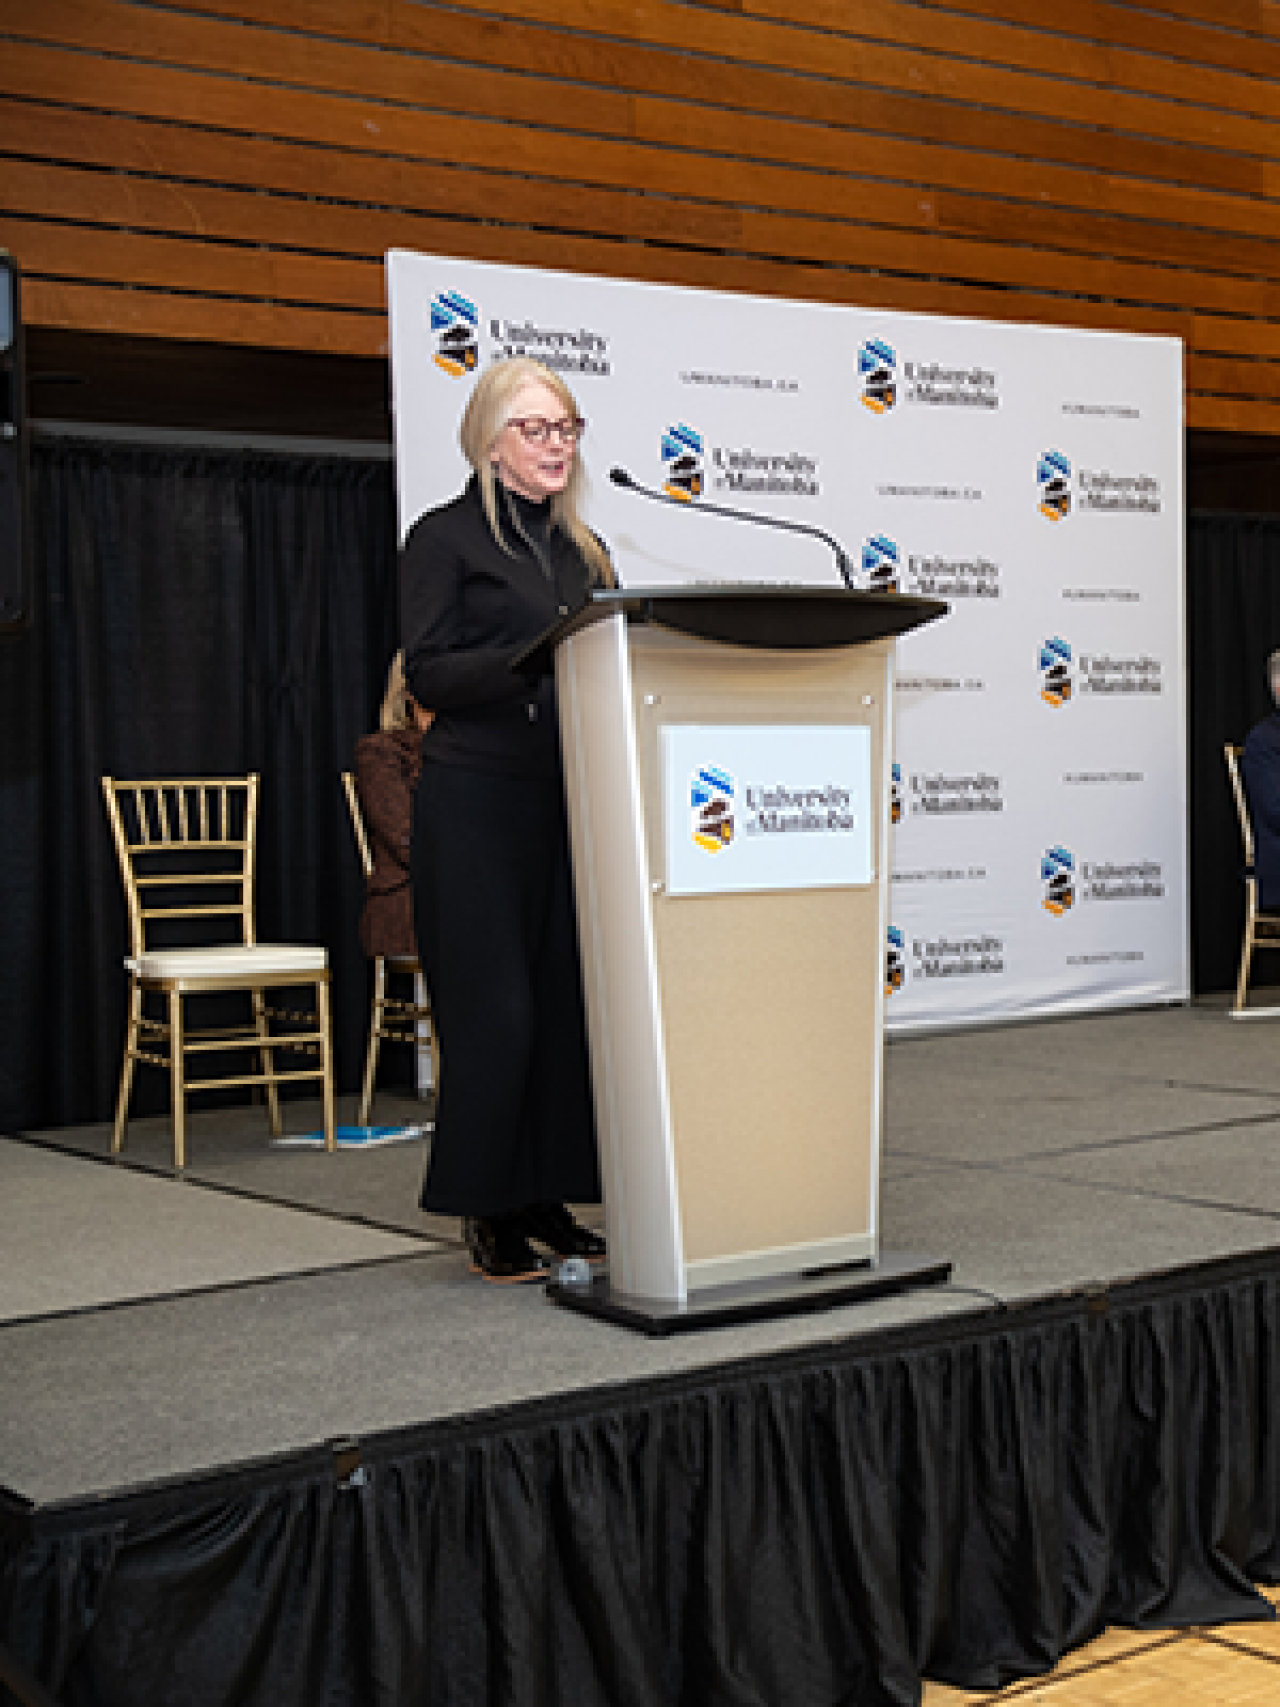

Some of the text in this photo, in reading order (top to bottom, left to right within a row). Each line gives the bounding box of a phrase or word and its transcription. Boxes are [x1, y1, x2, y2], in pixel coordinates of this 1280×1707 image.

[490, 319, 610, 351] University
[904, 361, 997, 389] University
[915, 383, 999, 411] Manitoba
[712, 446, 817, 474] University
[726, 472, 820, 496] Manitoba
[1079, 469, 1161, 496] University
[1087, 492, 1162, 513] Manitoba
[907, 554, 999, 579] University
[918, 575, 1000, 599] Manitoba
[1079, 655, 1162, 677] University
[1088, 677, 1162, 695] Manitoba
[912, 771, 1000, 793] University
[746, 783, 851, 812] University
[921, 796, 1004, 815] Manitoba
[758, 810, 854, 835] Manitoba
[1082, 860, 1162, 882] University
[1091, 881, 1166, 900] Manitoba
[913, 936, 1002, 957] University
[921, 955, 1004, 978] Manitoba
